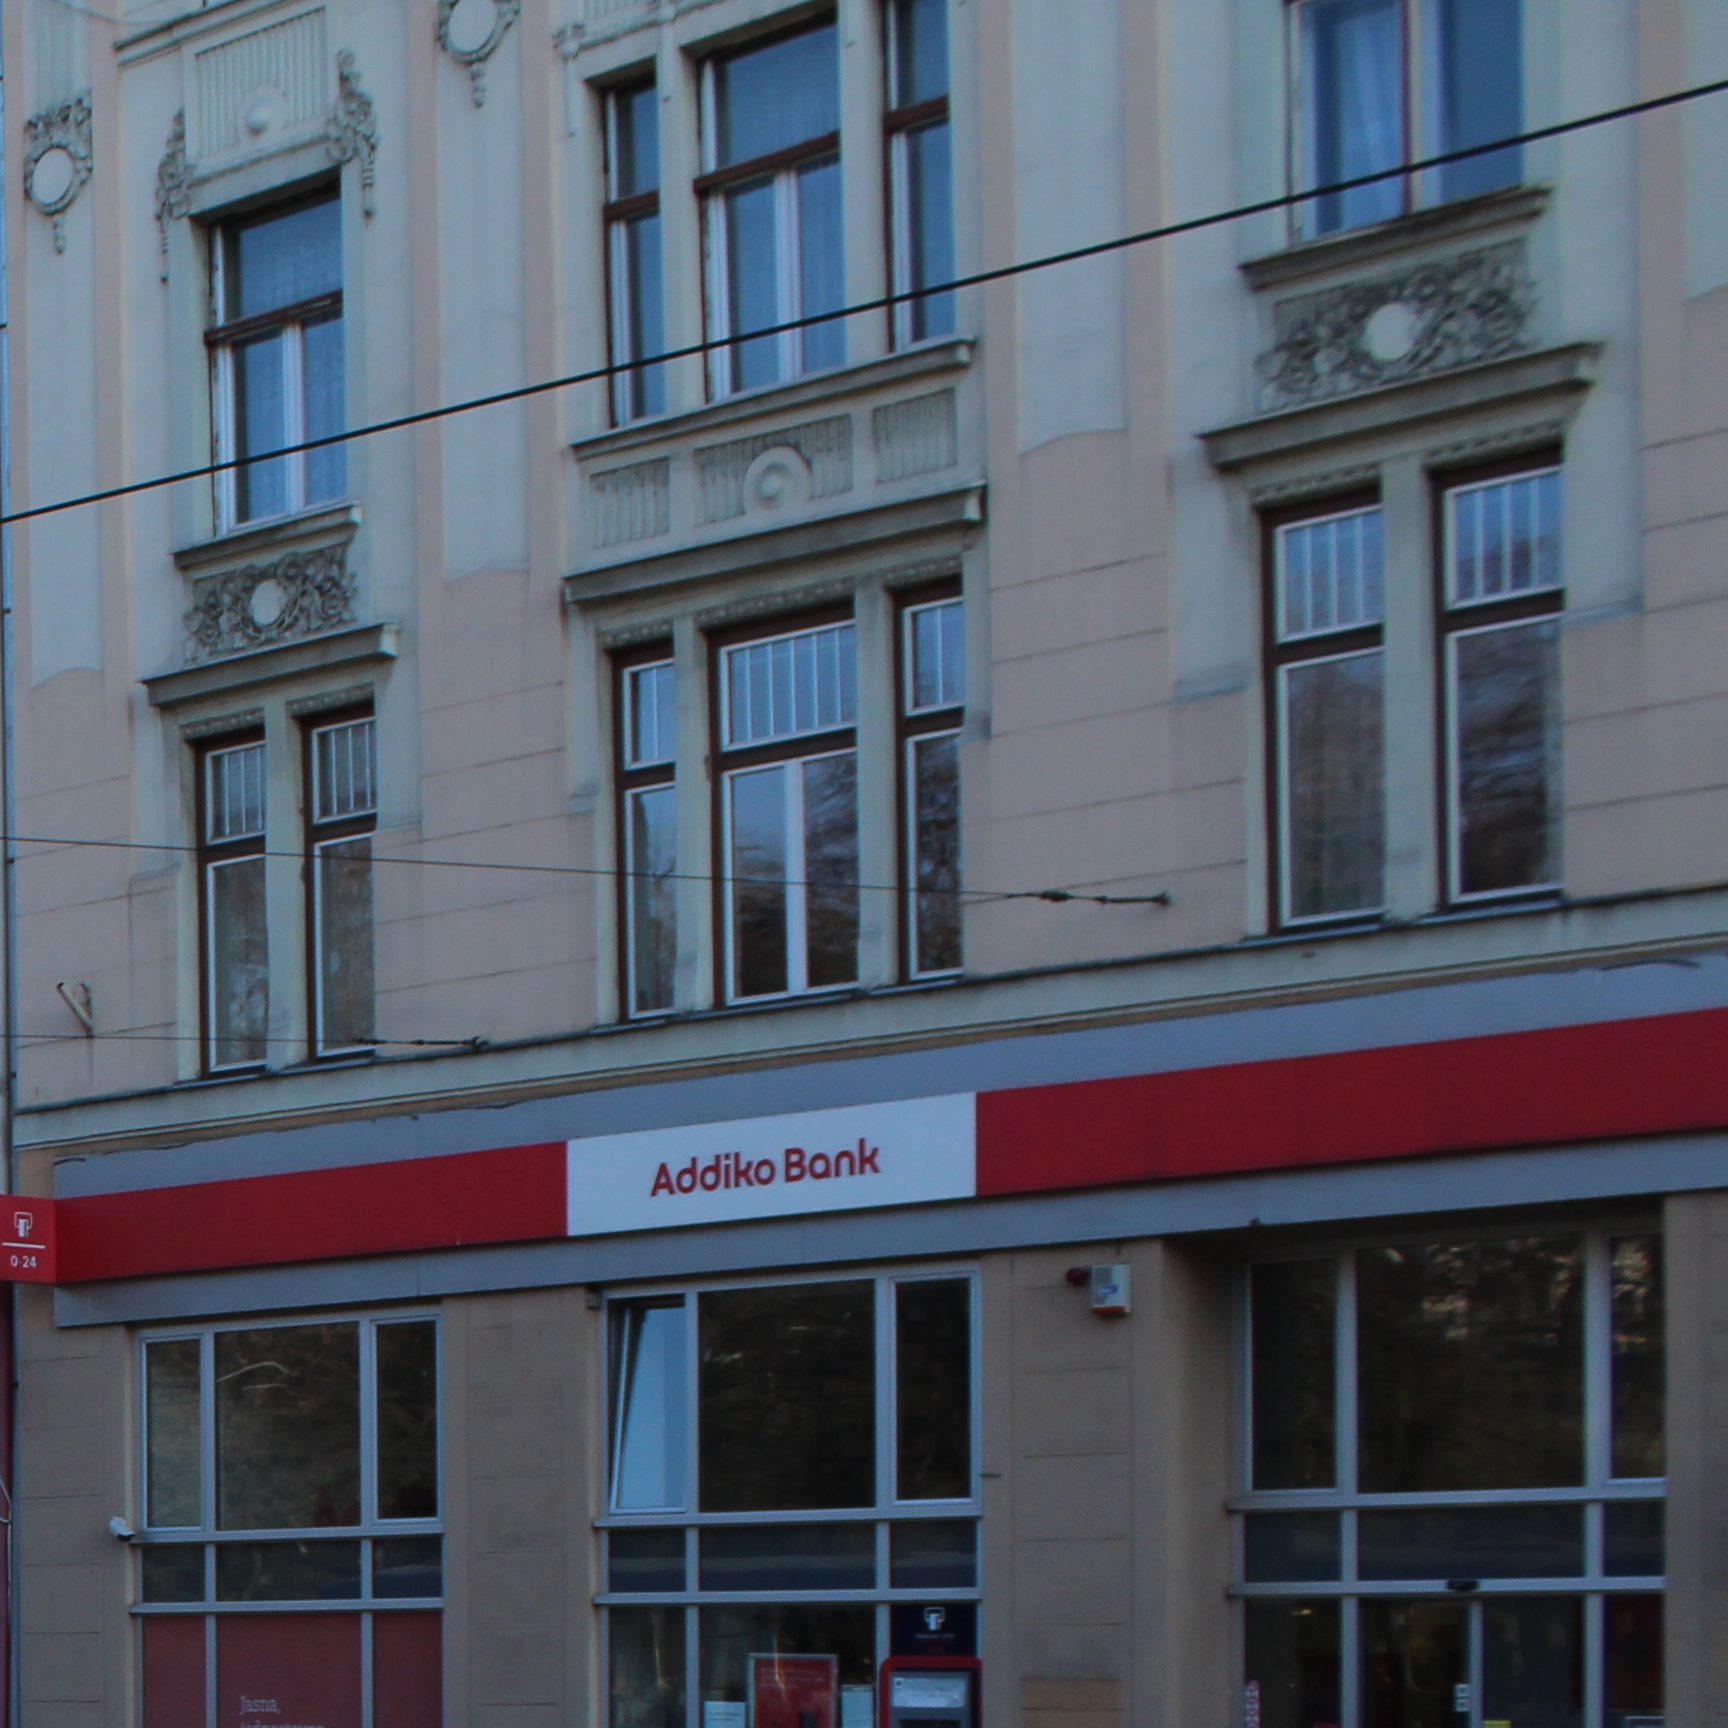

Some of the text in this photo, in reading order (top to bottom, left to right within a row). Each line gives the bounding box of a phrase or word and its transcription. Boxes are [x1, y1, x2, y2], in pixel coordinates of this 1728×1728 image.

[650, 1137, 880, 1197] Addiko Bank
[240, 1696, 281, 1716] Jasna,
